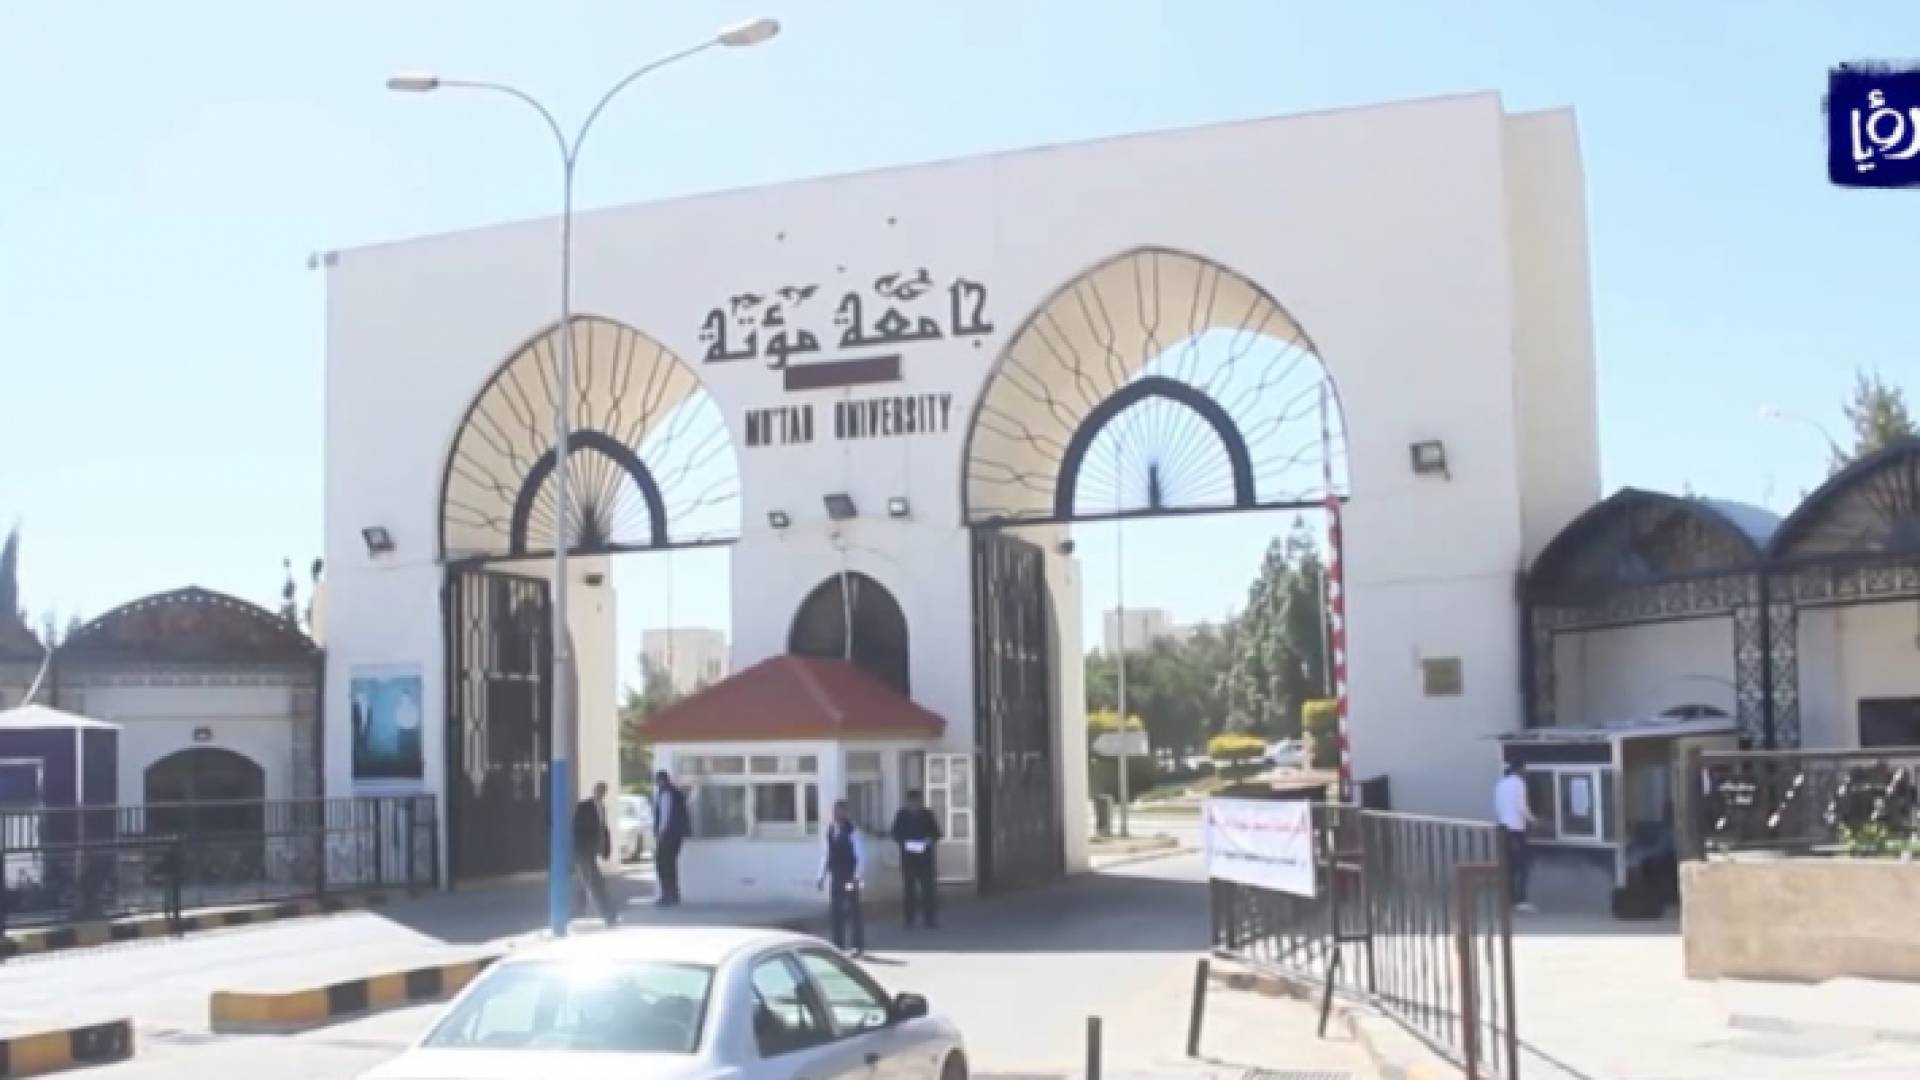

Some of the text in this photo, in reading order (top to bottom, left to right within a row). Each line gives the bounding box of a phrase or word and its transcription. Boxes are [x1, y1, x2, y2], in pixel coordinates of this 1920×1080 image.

[698, 269, 995, 370] جامعة مؤتة
[834, 393, 952, 440] UNIVERSITY
